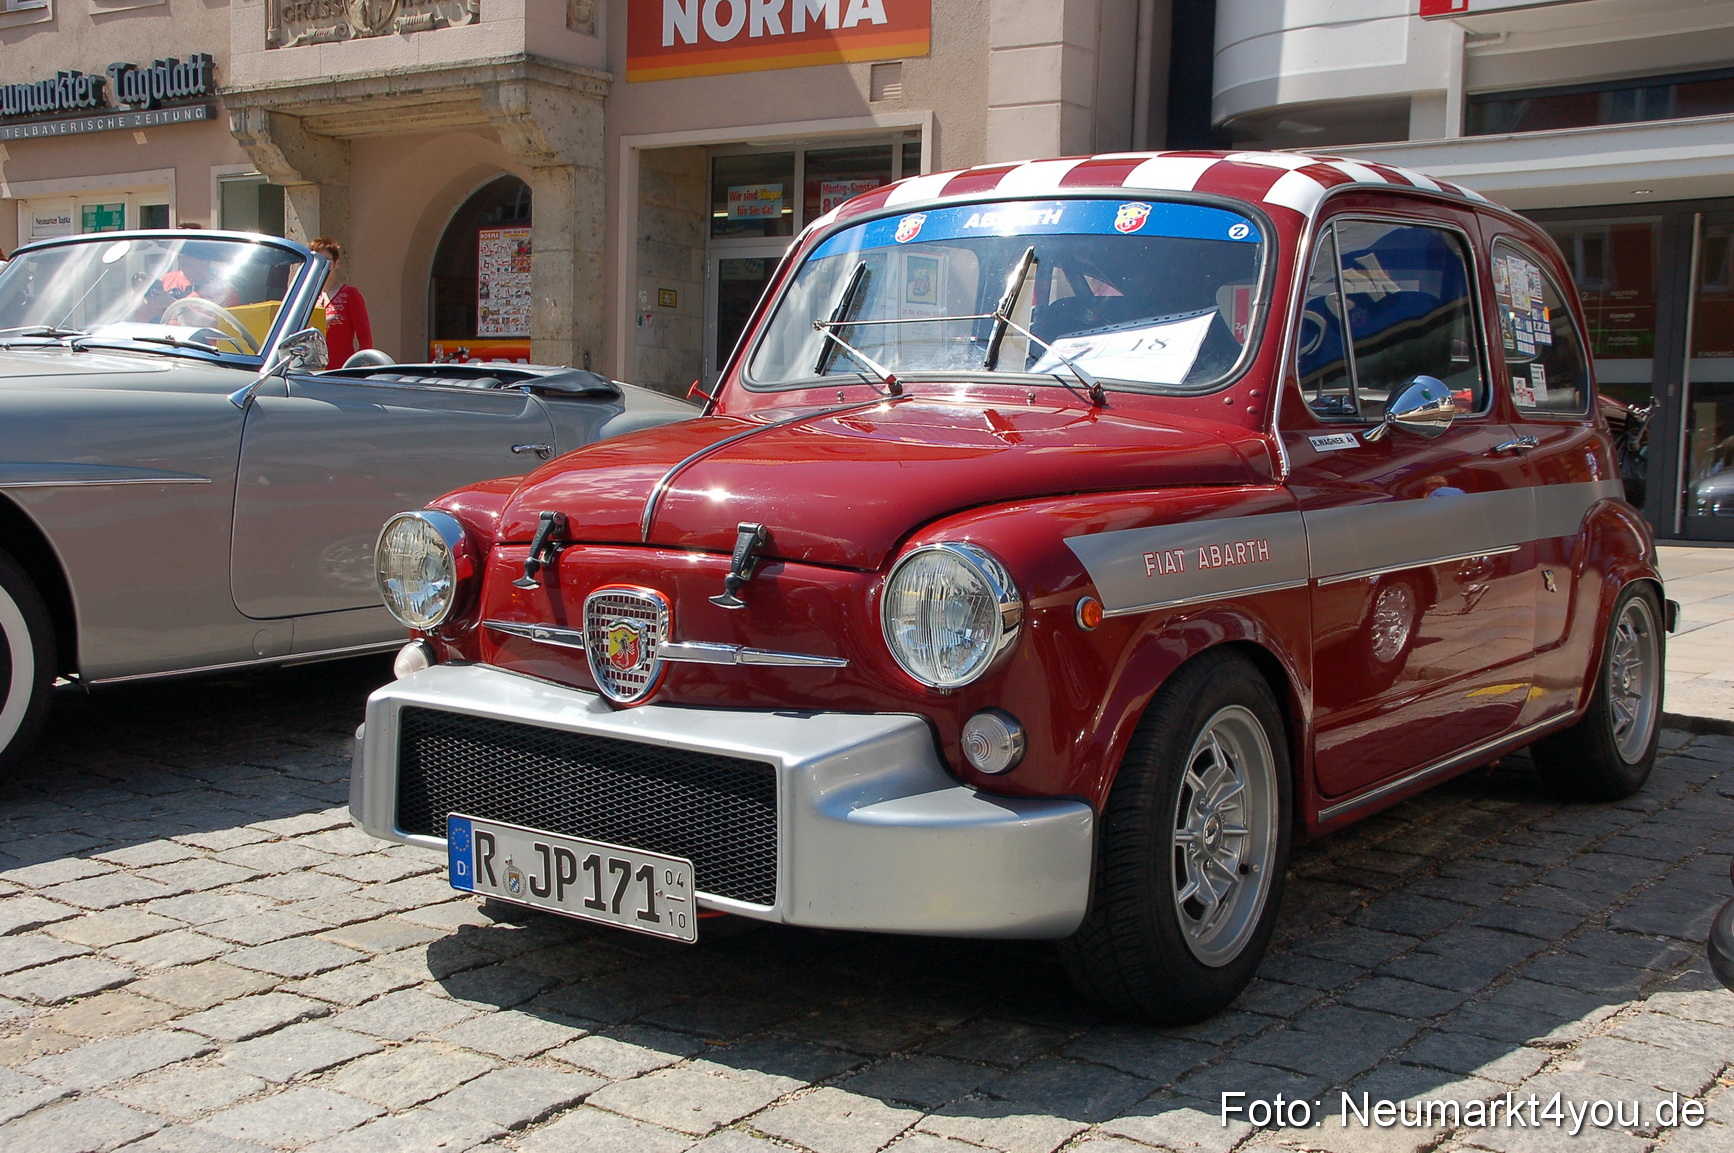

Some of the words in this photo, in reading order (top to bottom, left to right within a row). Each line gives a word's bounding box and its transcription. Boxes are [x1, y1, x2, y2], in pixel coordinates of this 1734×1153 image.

[660, 0, 888, 47] NORMA
[106, 53, 212, 110] Tagblatt
[135, 108, 203, 125] ZEITUNG
[729, 191, 742, 201] Wir
[743, 189, 758, 200] sind
[749, 205, 760, 215] Sie
[480, 231, 499, 239] NORMA
[1130, 337, 1170, 351] 18
[1143, 549, 1185, 577] FIAT
[1198, 539, 1269, 569] ABARTH
[474, 830, 497, 887] R
[457, 860, 467, 876] D
[665, 868, 684, 888] 04
[668, 909, 686, 928] 10
